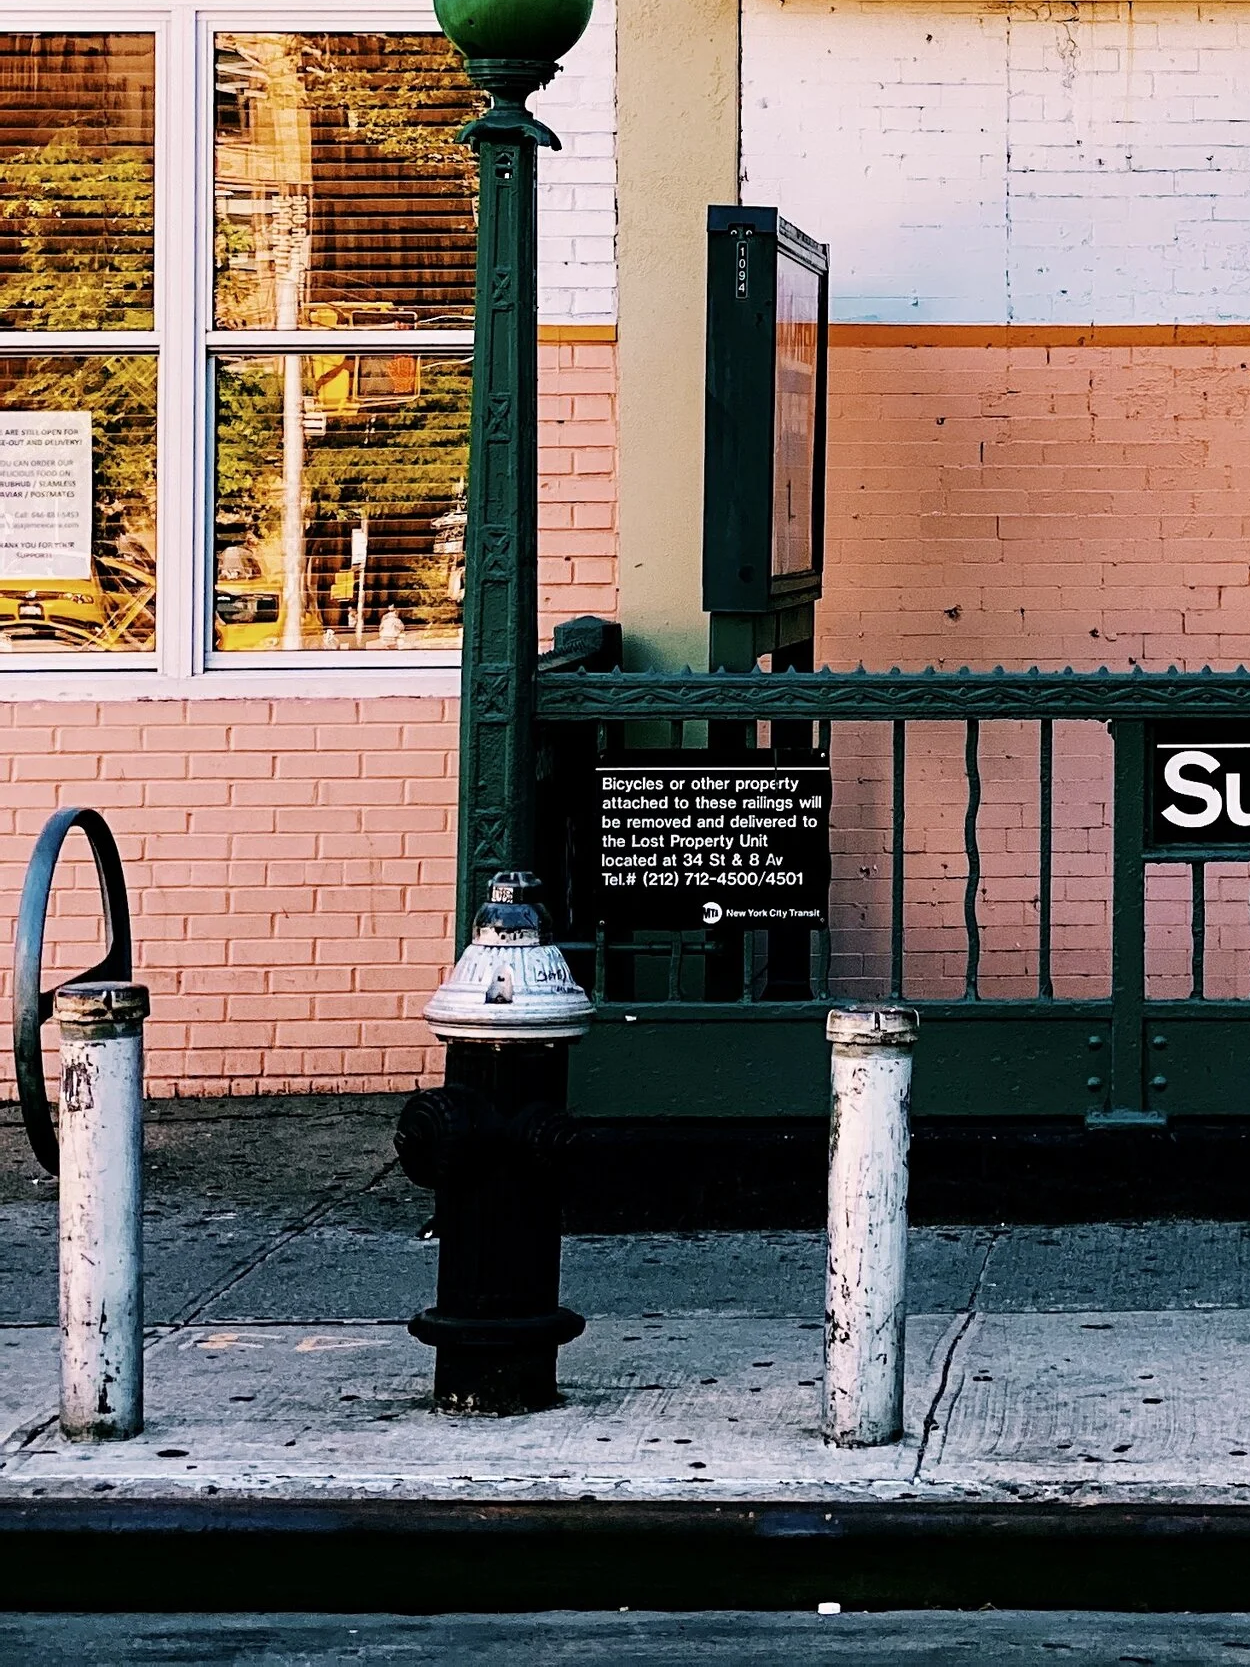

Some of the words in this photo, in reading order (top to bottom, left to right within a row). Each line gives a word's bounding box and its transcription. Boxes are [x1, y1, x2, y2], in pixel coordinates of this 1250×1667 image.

[738, 247, 746, 293] 1094
[602, 777, 664, 793] Bicycles
[669, 780, 686, 791] or
[691, 777, 731, 791] other
[735, 777, 799, 793] property
[602, 796, 669, 810] attached
[674, 796, 689, 809] to
[695, 796, 737, 810] these
[742, 796, 794, 812] railings
[799, 796, 822, 809] will
[602, 815, 621, 829] be
[626, 815, 692, 829] removed
[697, 815, 725, 829] and
[730, 815, 797, 829] delivered
[802, 816, 818, 828] to
[602, 834, 626, 848] the
[631, 834, 665, 848] Lost
[670, 834, 734, 850] Property
[739, 834, 769, 848] Unit
[601, 853, 657, 867] located
[662, 853, 677, 867] at
[682, 853, 704, 867] 34
[708, 853, 726, 867] St
[731, 853, 743, 867] &
[748, 853, 760, 867] 8
[765, 853, 784, 867] Av
[602, 872, 637, 886] Tel.#
[642, 871, 679, 888] (212)
[684, 871, 804, 887] 712-4500/4501
[726, 908, 746, 918] New
[748, 908, 768, 918] York
[769, 908, 788, 919] City
[789, 908, 820, 918] Transit
